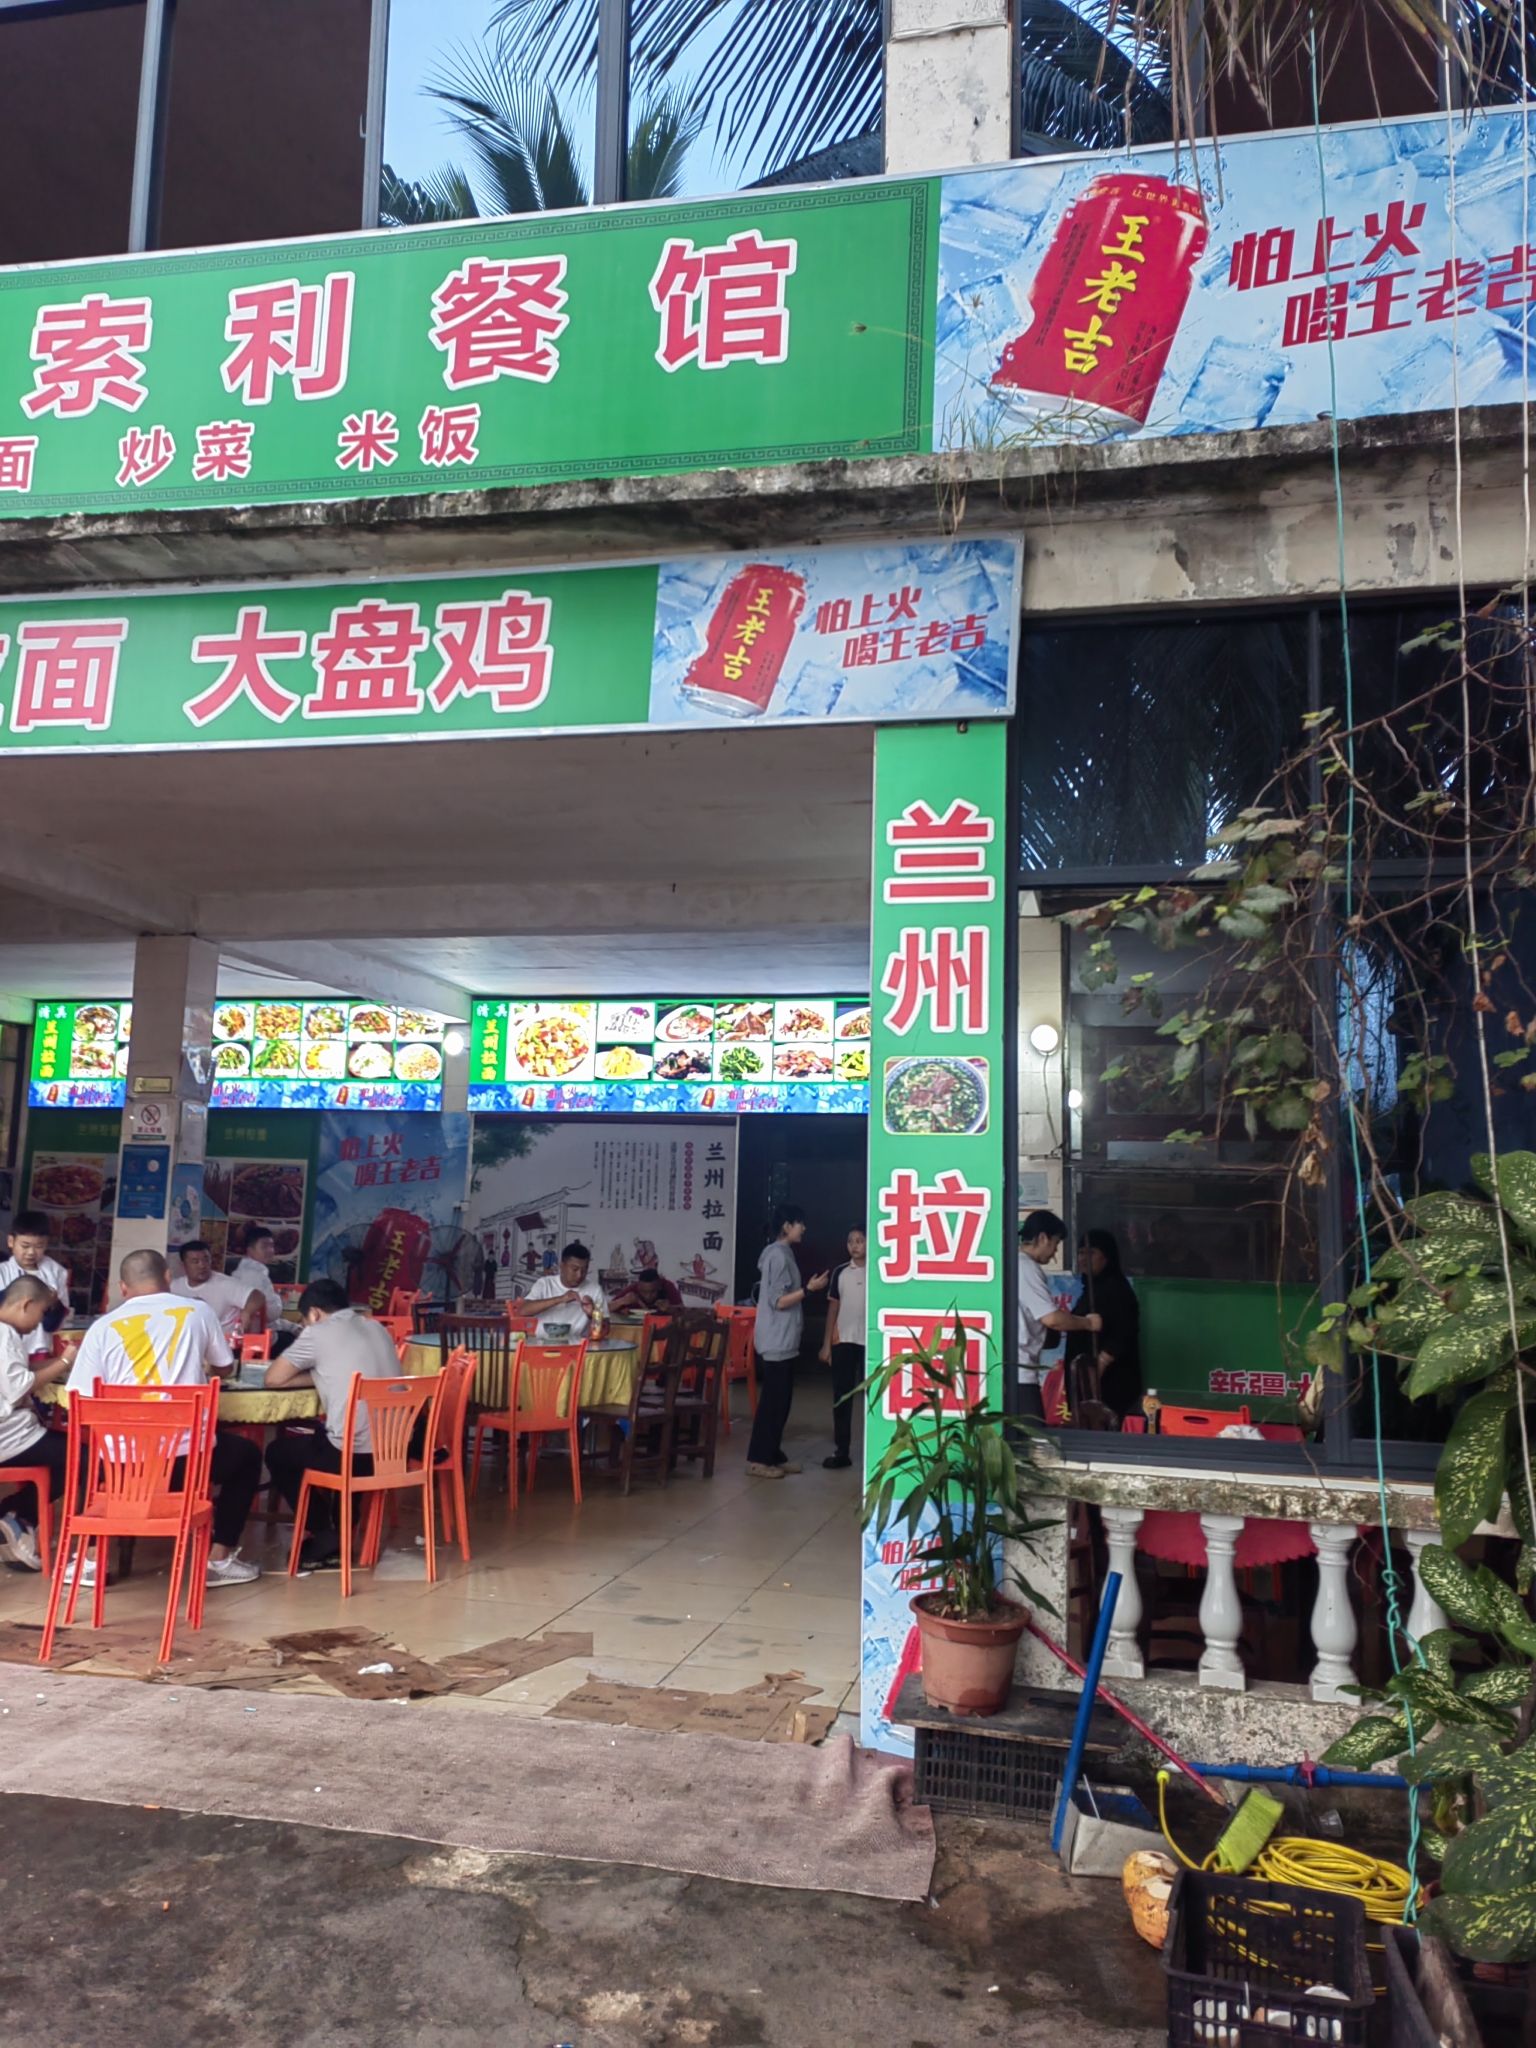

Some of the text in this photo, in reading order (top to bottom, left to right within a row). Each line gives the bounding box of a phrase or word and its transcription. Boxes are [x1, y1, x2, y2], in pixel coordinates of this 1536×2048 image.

[1228, 200, 1427, 292] 怕上火
[20, 229, 797, 419] 索利餐馆
[1063, 213, 1149, 375] 王老吉
[1282, 243, 1536, 348] 喝王老吉
[114, 420, 256, 488] 炒菜
[337, 403, 482, 472] 米饭
[723, 587, 774, 681] 王老吉
[815, 585, 922, 635] 怕上火
[842, 614, 989, 669] 喝王老吉
[0, 589, 554, 734] 面 大盘鸡
[339, 1132, 404, 1161] 怕上火
[354, 1155, 442, 1187] 喝王老吉
[702, 1141, 726, 1251] 兰州拉面
